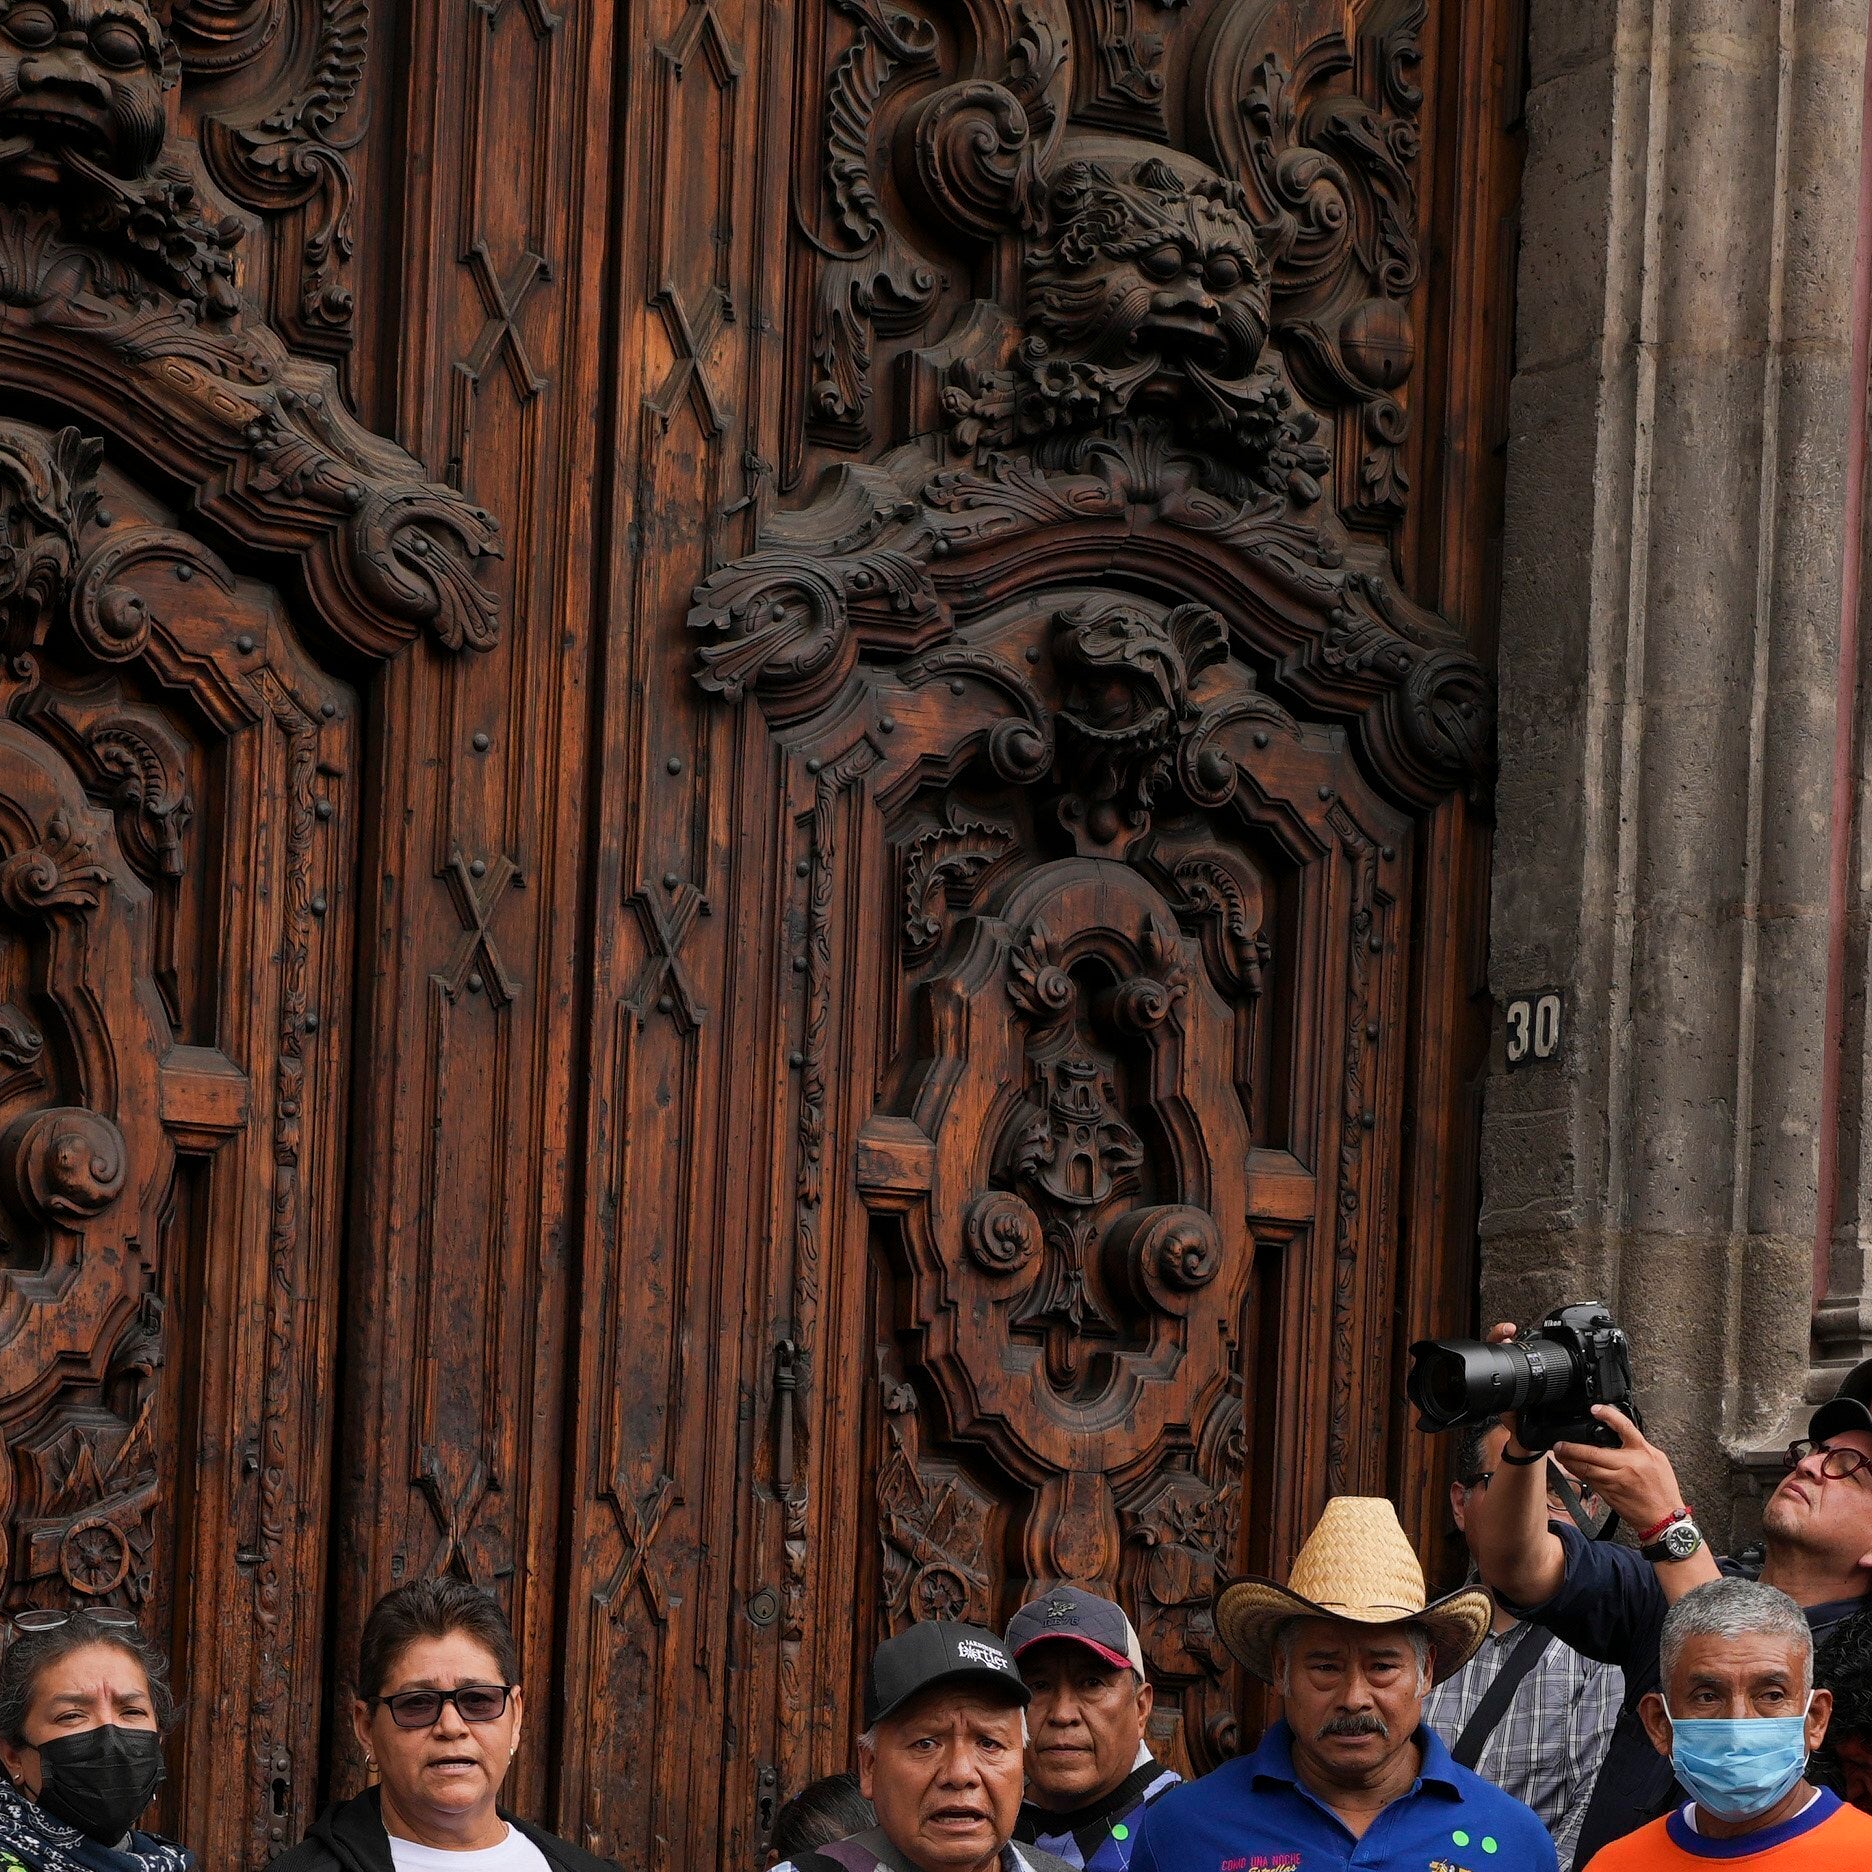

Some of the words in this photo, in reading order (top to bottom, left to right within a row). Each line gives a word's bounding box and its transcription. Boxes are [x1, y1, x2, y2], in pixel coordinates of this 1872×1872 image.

[1507, 995, 1560, 1061] 30
[1251, 1856, 1267, 1867] UNA
[1272, 1853, 1301, 1866] NOCHE
